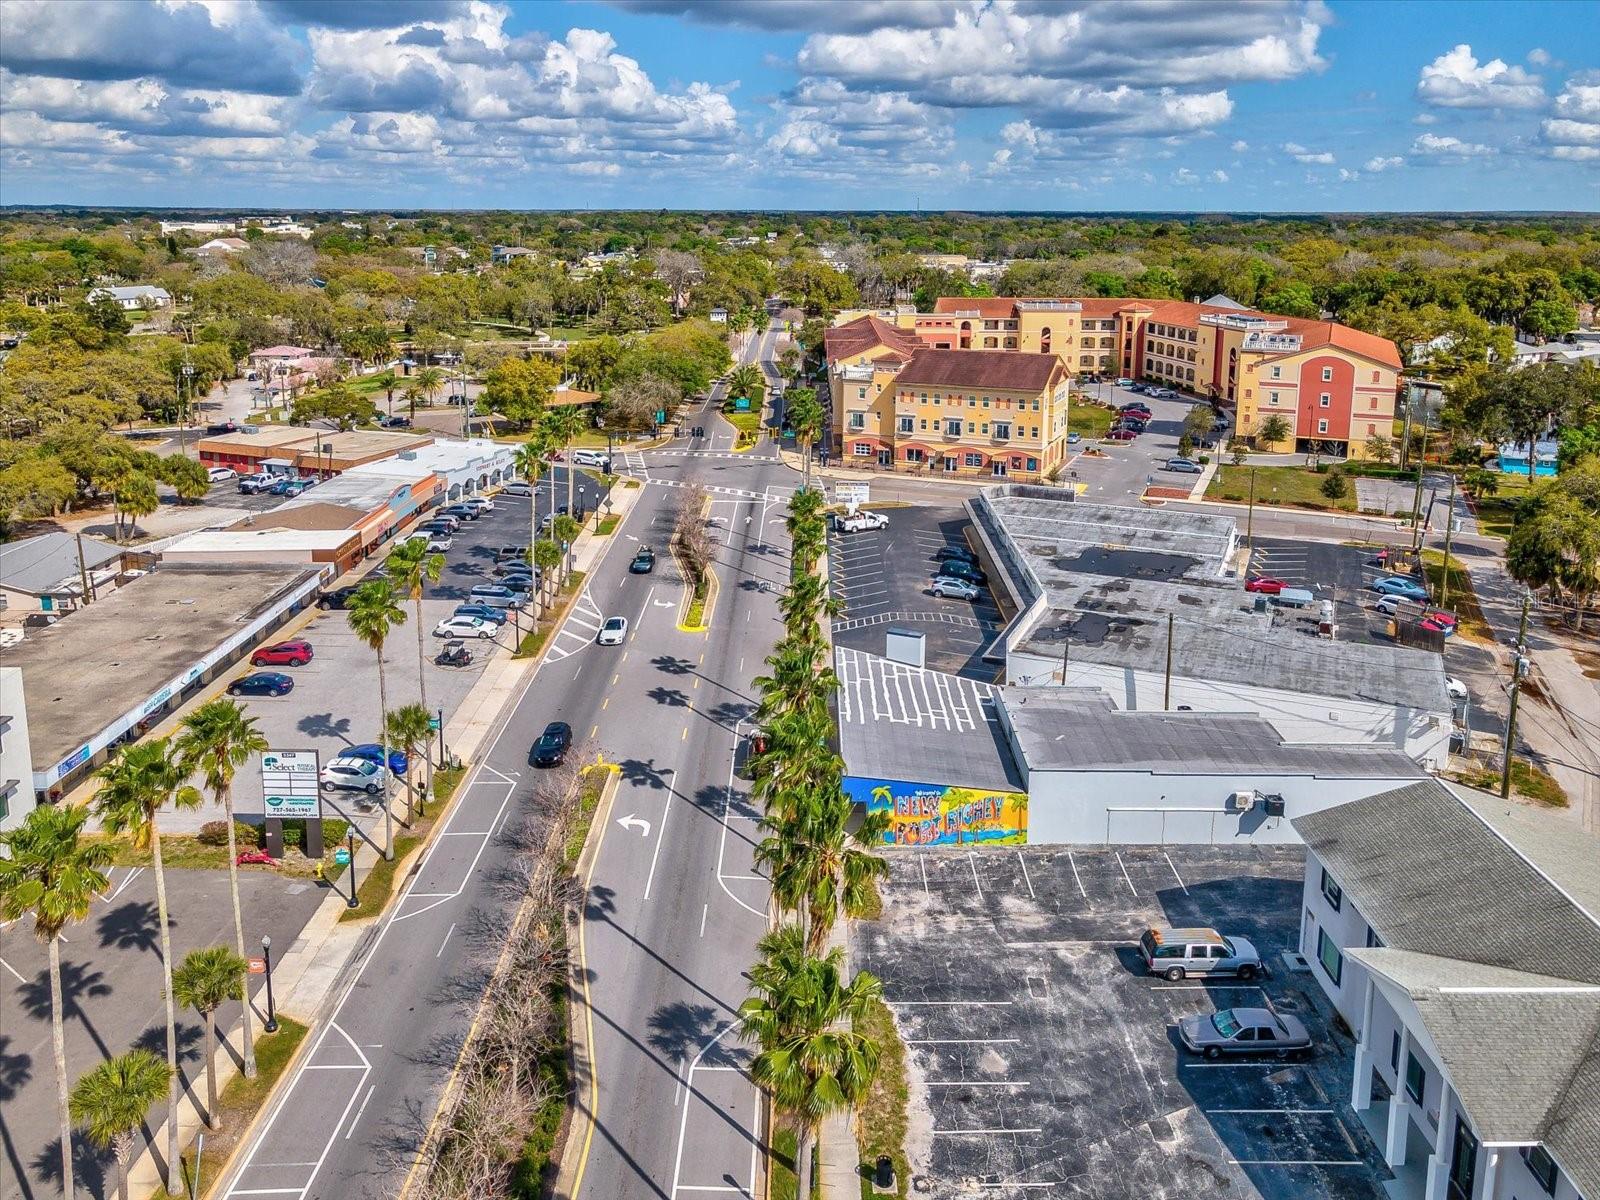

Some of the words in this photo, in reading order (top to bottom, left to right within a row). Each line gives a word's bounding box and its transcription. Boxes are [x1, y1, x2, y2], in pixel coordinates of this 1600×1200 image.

[272, 763, 295, 771] Select
[895, 795, 940, 816] NEW
[944, 796, 1003, 834] RICHEY
[895, 816, 941, 845] PORT
